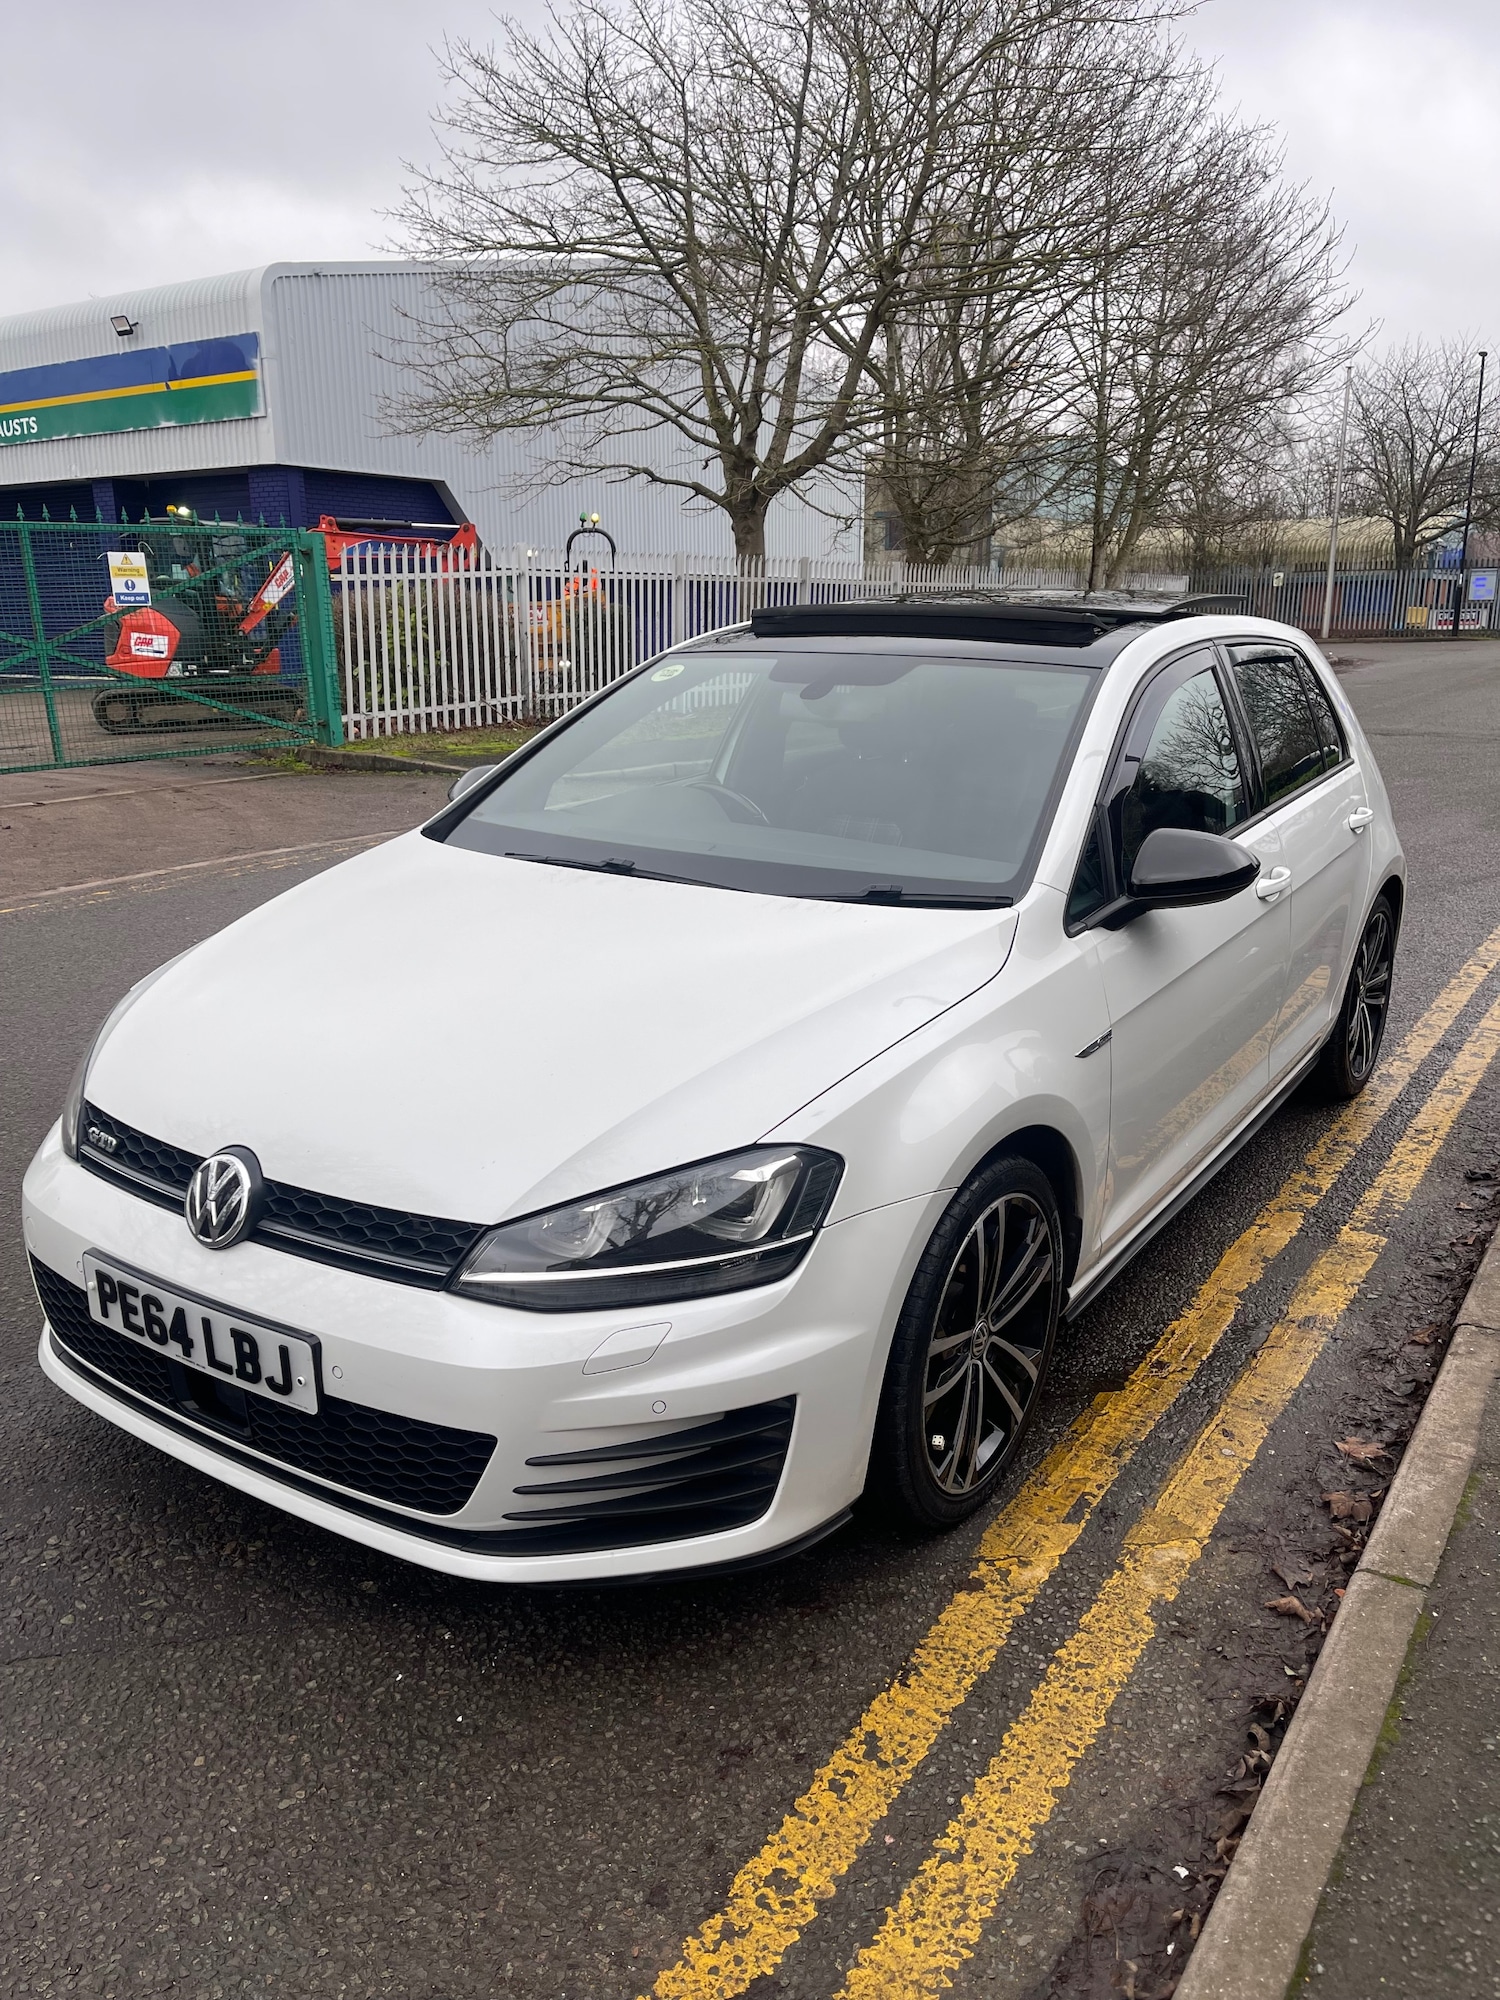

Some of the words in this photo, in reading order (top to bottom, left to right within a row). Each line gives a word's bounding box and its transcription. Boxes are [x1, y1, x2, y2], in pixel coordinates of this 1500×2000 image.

[88, 1126, 117, 1153] GTD
[95, 1269, 194, 1358] PE64
[201, 1316, 293, 1396] LBJ
